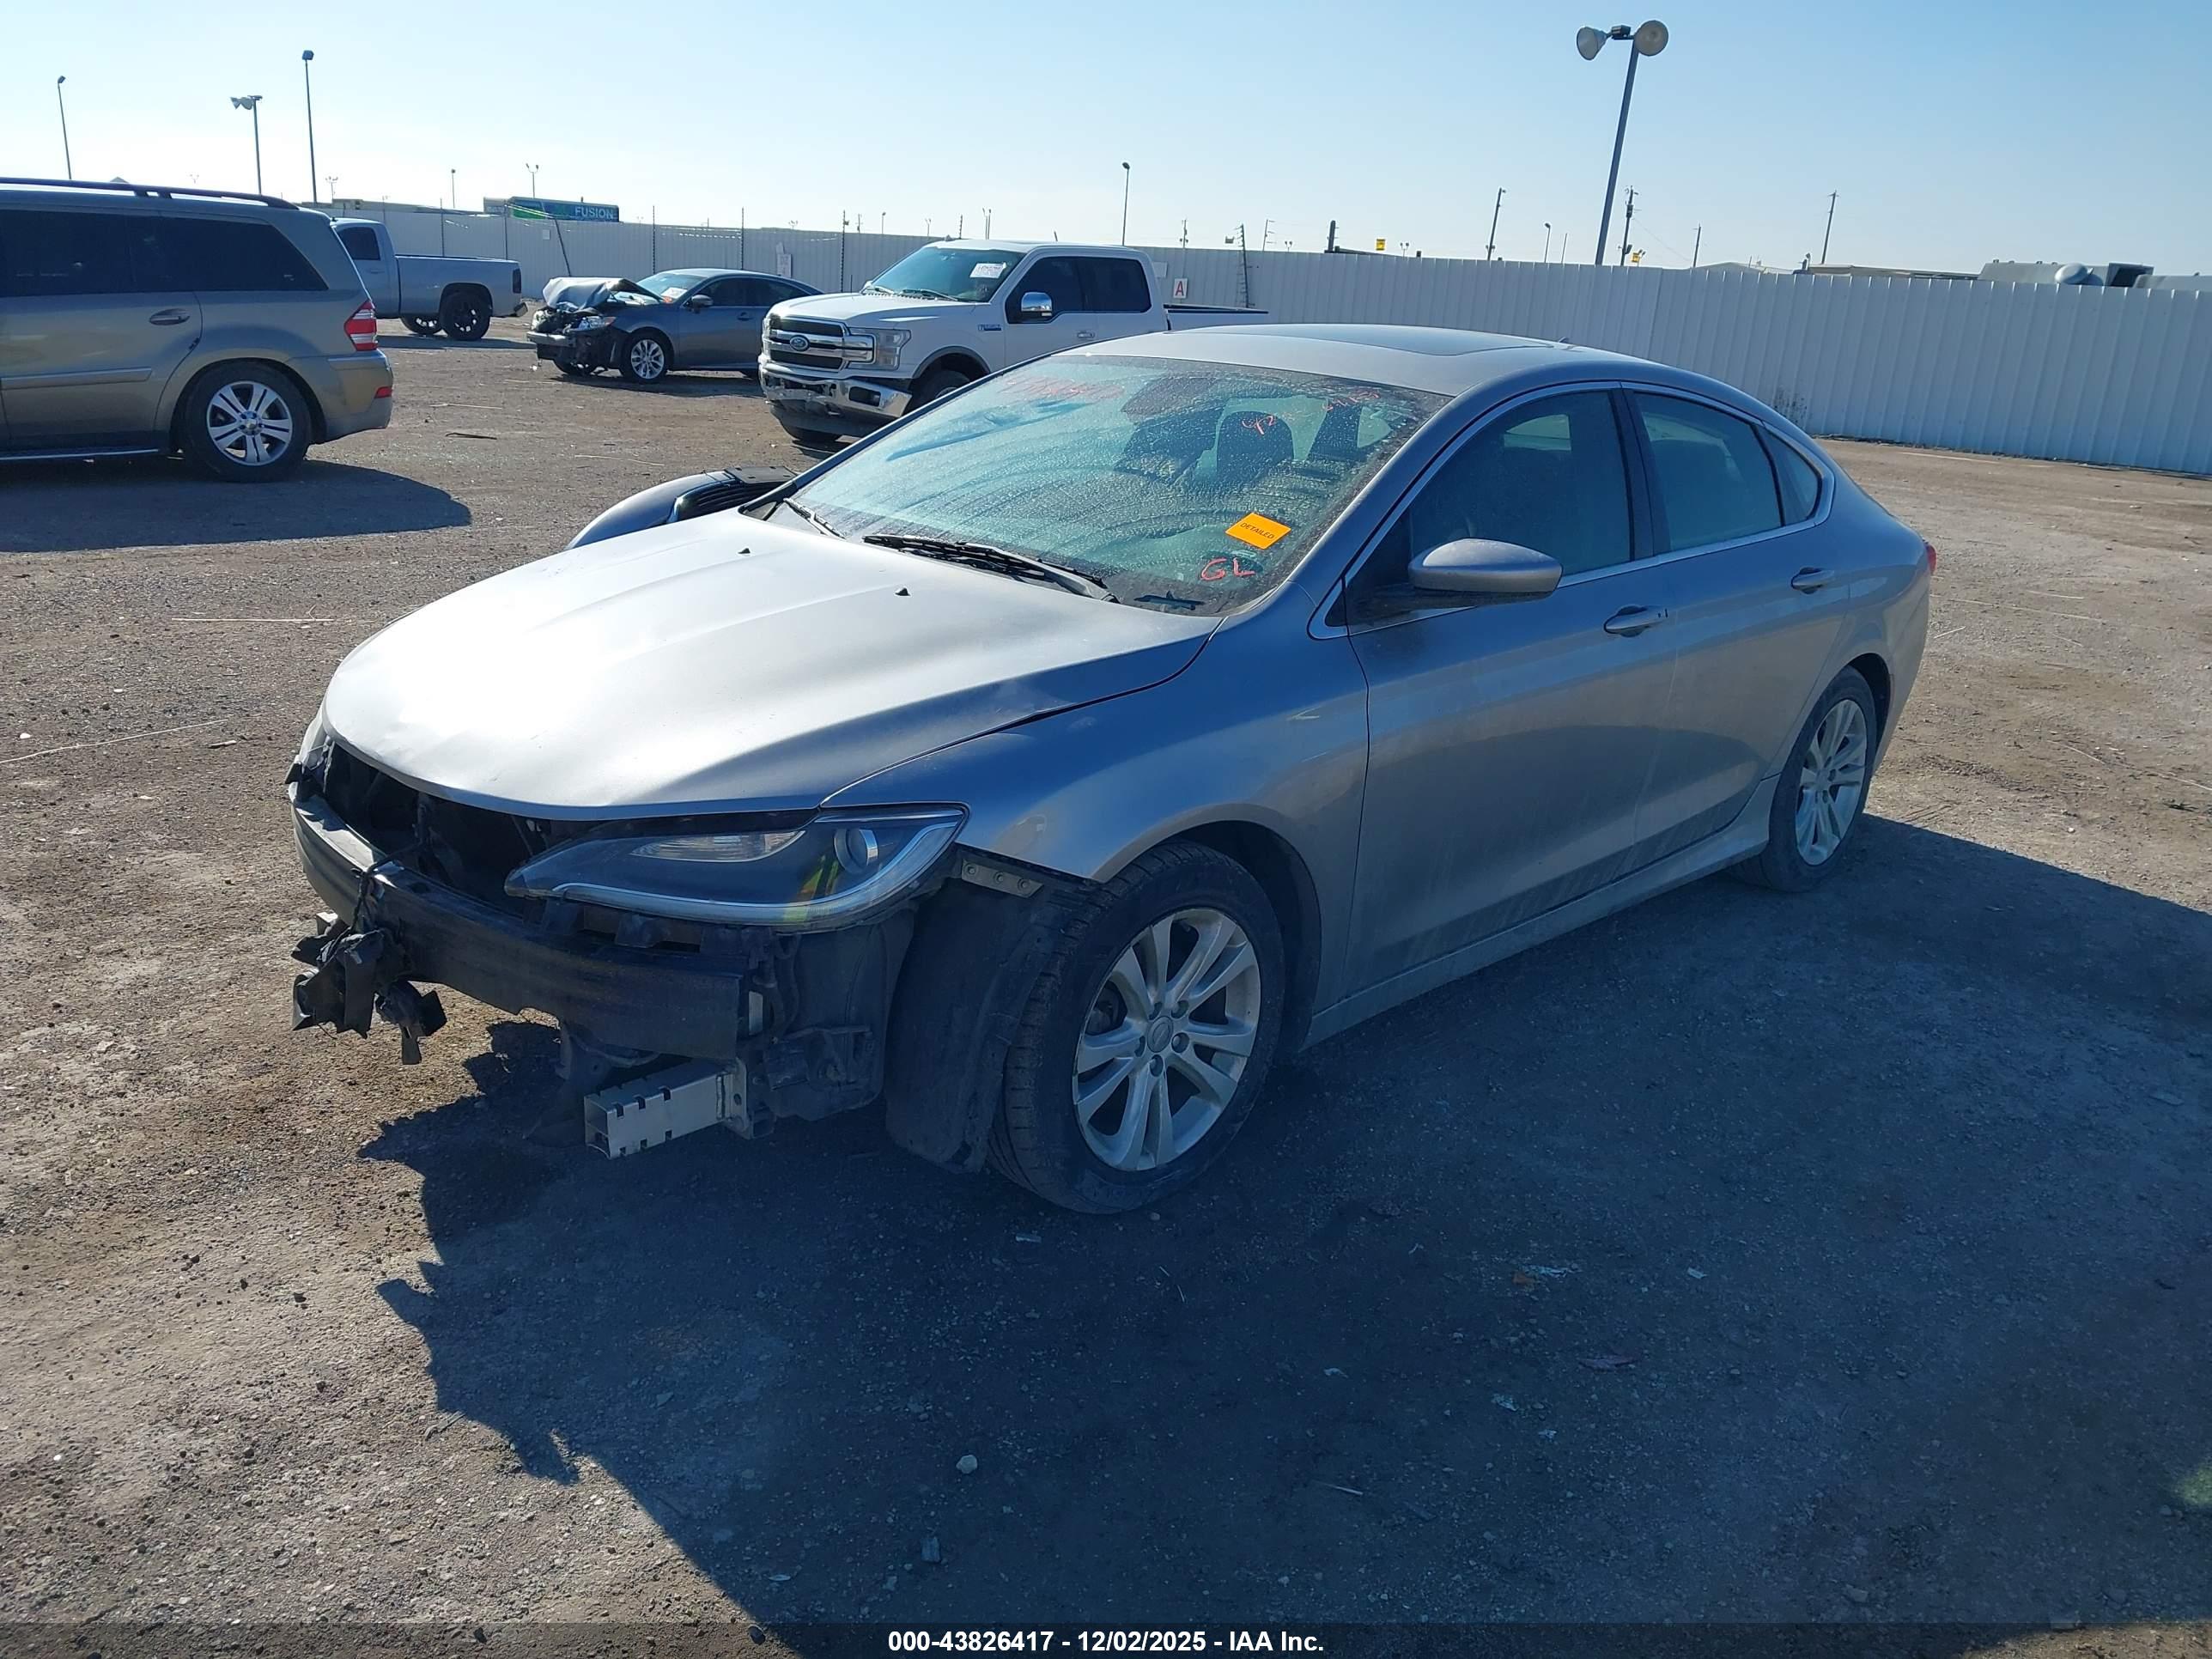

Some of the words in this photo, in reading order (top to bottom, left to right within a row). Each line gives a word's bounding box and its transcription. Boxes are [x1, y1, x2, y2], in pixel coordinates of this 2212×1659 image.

[575, 206, 614, 220] FUSION
[1175, 280, 1185, 296] A
[1240, 522, 1275, 539] DETAILED
